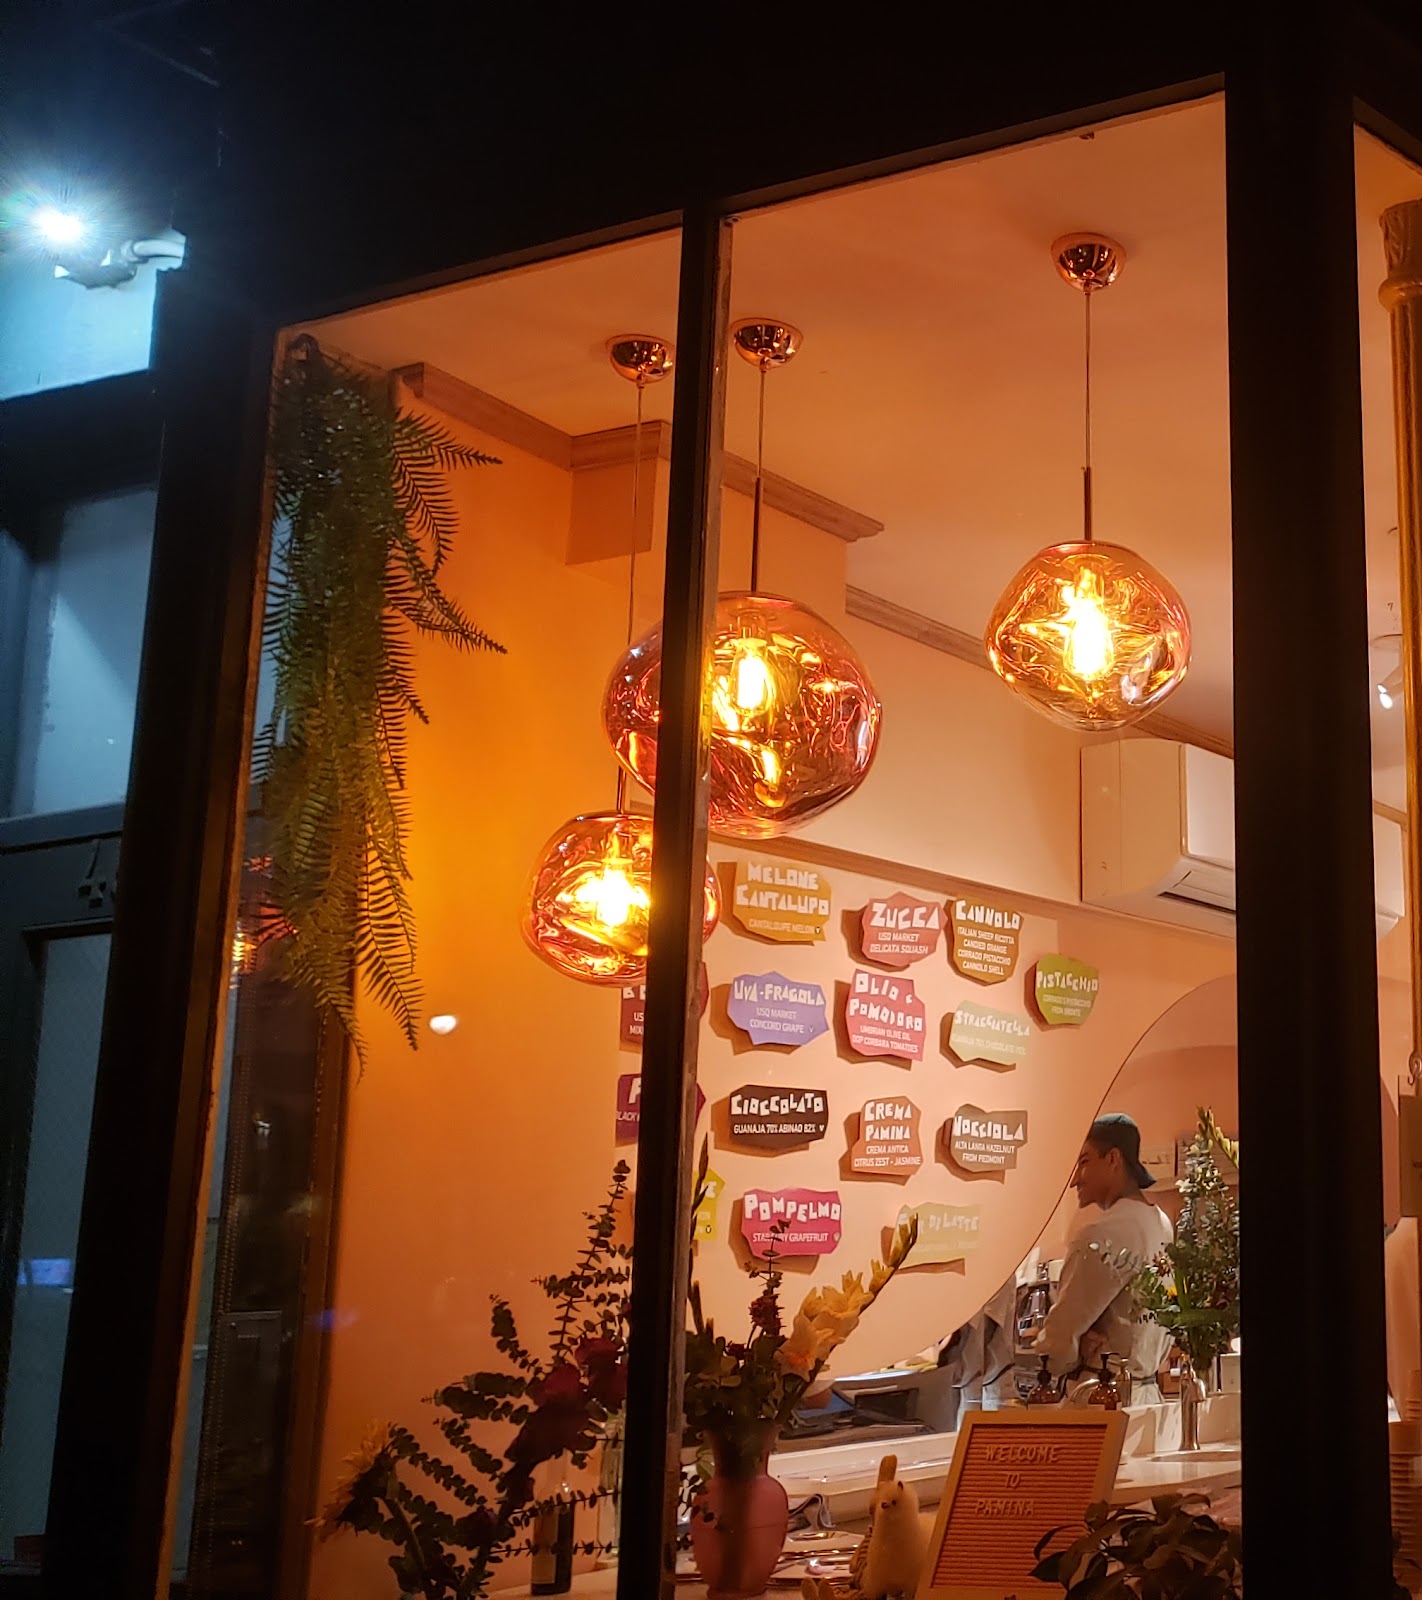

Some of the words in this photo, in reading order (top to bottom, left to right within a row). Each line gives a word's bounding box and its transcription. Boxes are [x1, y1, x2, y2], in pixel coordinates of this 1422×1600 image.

[748, 862, 819, 890] MELONE
[736, 884, 829, 915] CANTALUPO
[870, 902, 940, 930] ZUCCA
[956, 900, 1021, 930] CANNOLO
[892, 932, 920, 942] MARKET
[900, 944, 929, 954] SQUASH
[855, 973, 899, 1001] OLIO
[1036, 970, 1098, 993] PISTACCHIO
[770, 1009, 797, 1019] MARKET
[849, 998, 923, 1032] POMODORO
[955, 1010, 1030, 1037] STRACCIATELLA
[749, 1019, 781, 1031] CONCORD
[781, 1023, 805, 1034] GRAPE
[731, 1092, 824, 1116] CIOCCOLATO
[864, 1101, 912, 1121] CREMA
[865, 1124, 911, 1142] PAMINA
[954, 1115, 1024, 1140] NOCCIOLA
[887, 1144, 909, 1153] ANTICA
[962, 1152, 978, 1162] FROM
[986, 1143, 1015, 1154] HAZELNUT
[854, 1157, 875, 1167] CITRUS
[894, 1156, 921, 1166] JASMINE
[744, 1193, 841, 1223] POMPELMO
[942, 1212, 979, 1232] LATTE
[789, 1232, 829, 1243] GRAPEFRUIT
[986, 1445, 1062, 1463] WELCOME
[1005, 1473, 1021, 1490] TO
